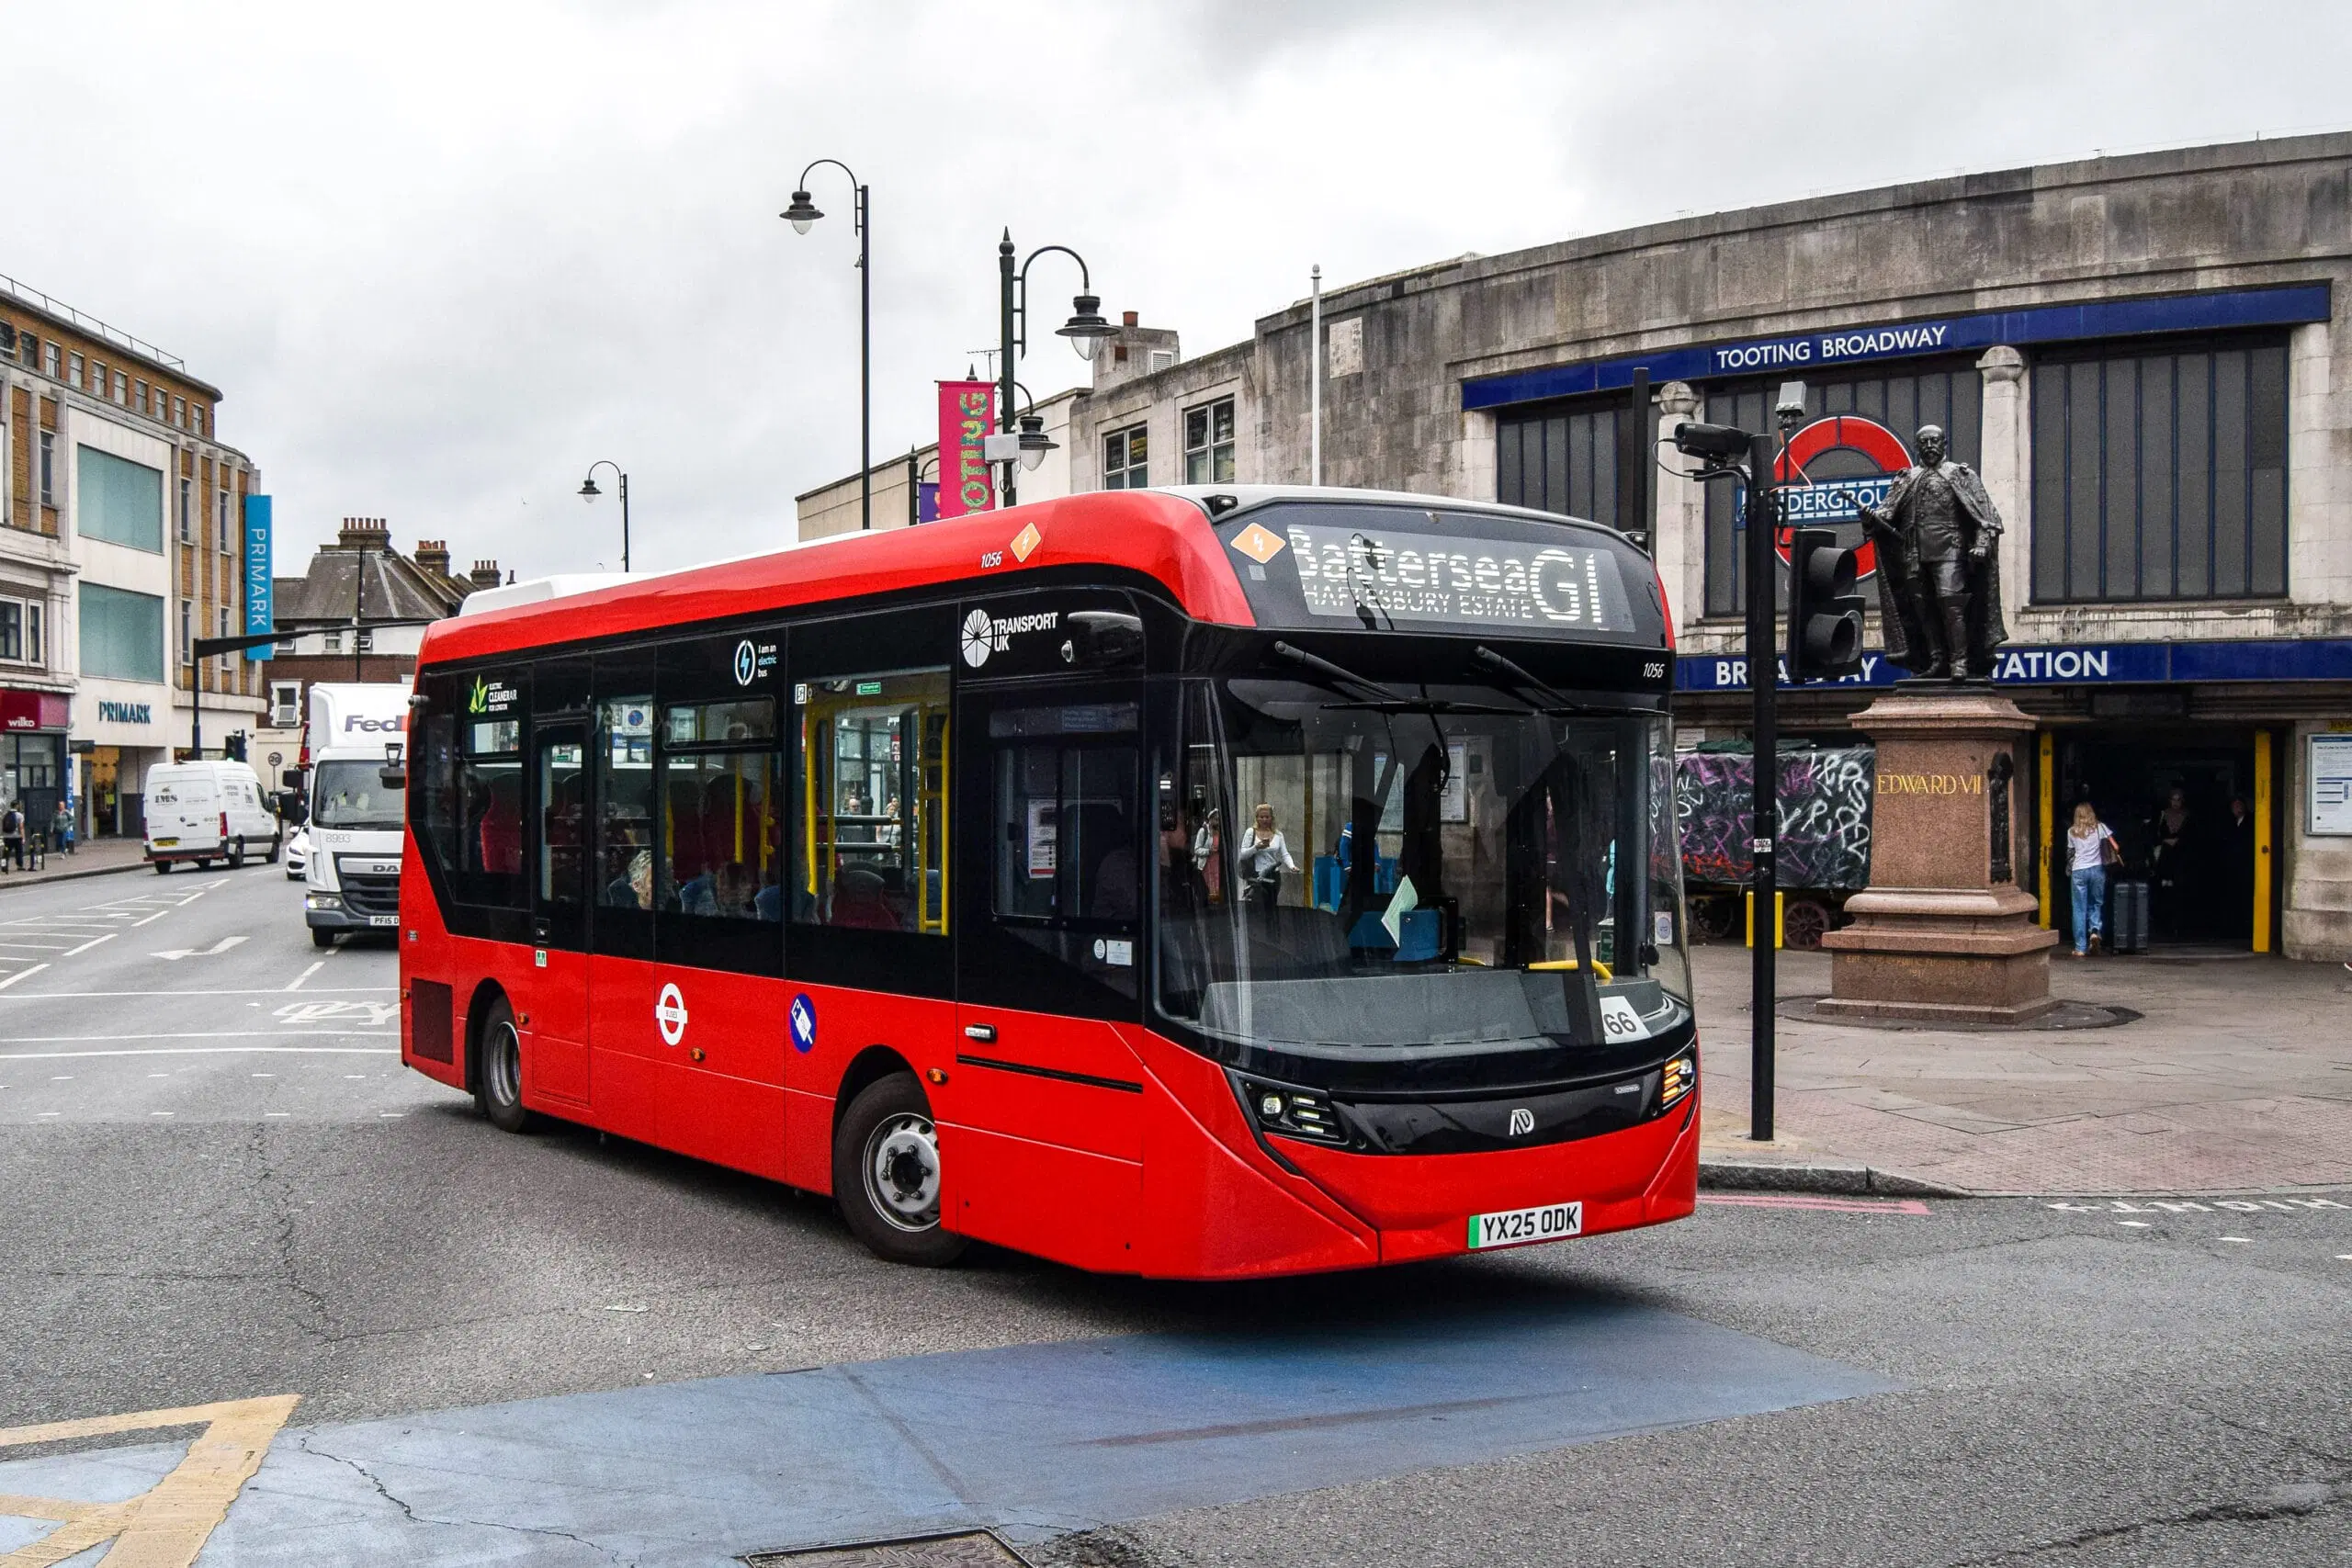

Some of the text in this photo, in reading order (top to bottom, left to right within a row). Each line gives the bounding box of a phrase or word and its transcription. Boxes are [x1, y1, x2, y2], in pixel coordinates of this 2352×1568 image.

[1716, 325, 1946, 369] TOOTING BROADWAY
[959, 392, 989, 515] OTING
[980, 551, 1003, 570] 1056
[1287, 528, 1528, 595] Battersea
[250, 528, 266, 626] PRIMARK
[1459, 594, 1534, 620] ESTATE
[992, 612, 1058, 636] TRANSPORT
[993, 634, 1010, 652] UK
[758, 669, 768, 678] bus
[1643, 662, 1665, 679] 1056
[1992, 650, 2108, 679] TATION
[7, 716, 36, 728] wilko
[98, 701, 152, 724] PRIMARK
[345, 715, 408, 732] Fed
[1877, 774, 1982, 795] EDWARD VII
[325, 833, 351, 843] 8993
[372, 864, 400, 873] DA
[1603, 1011, 1637, 1037] 66
[1483, 1206, 1578, 1241] YX25 ODK
